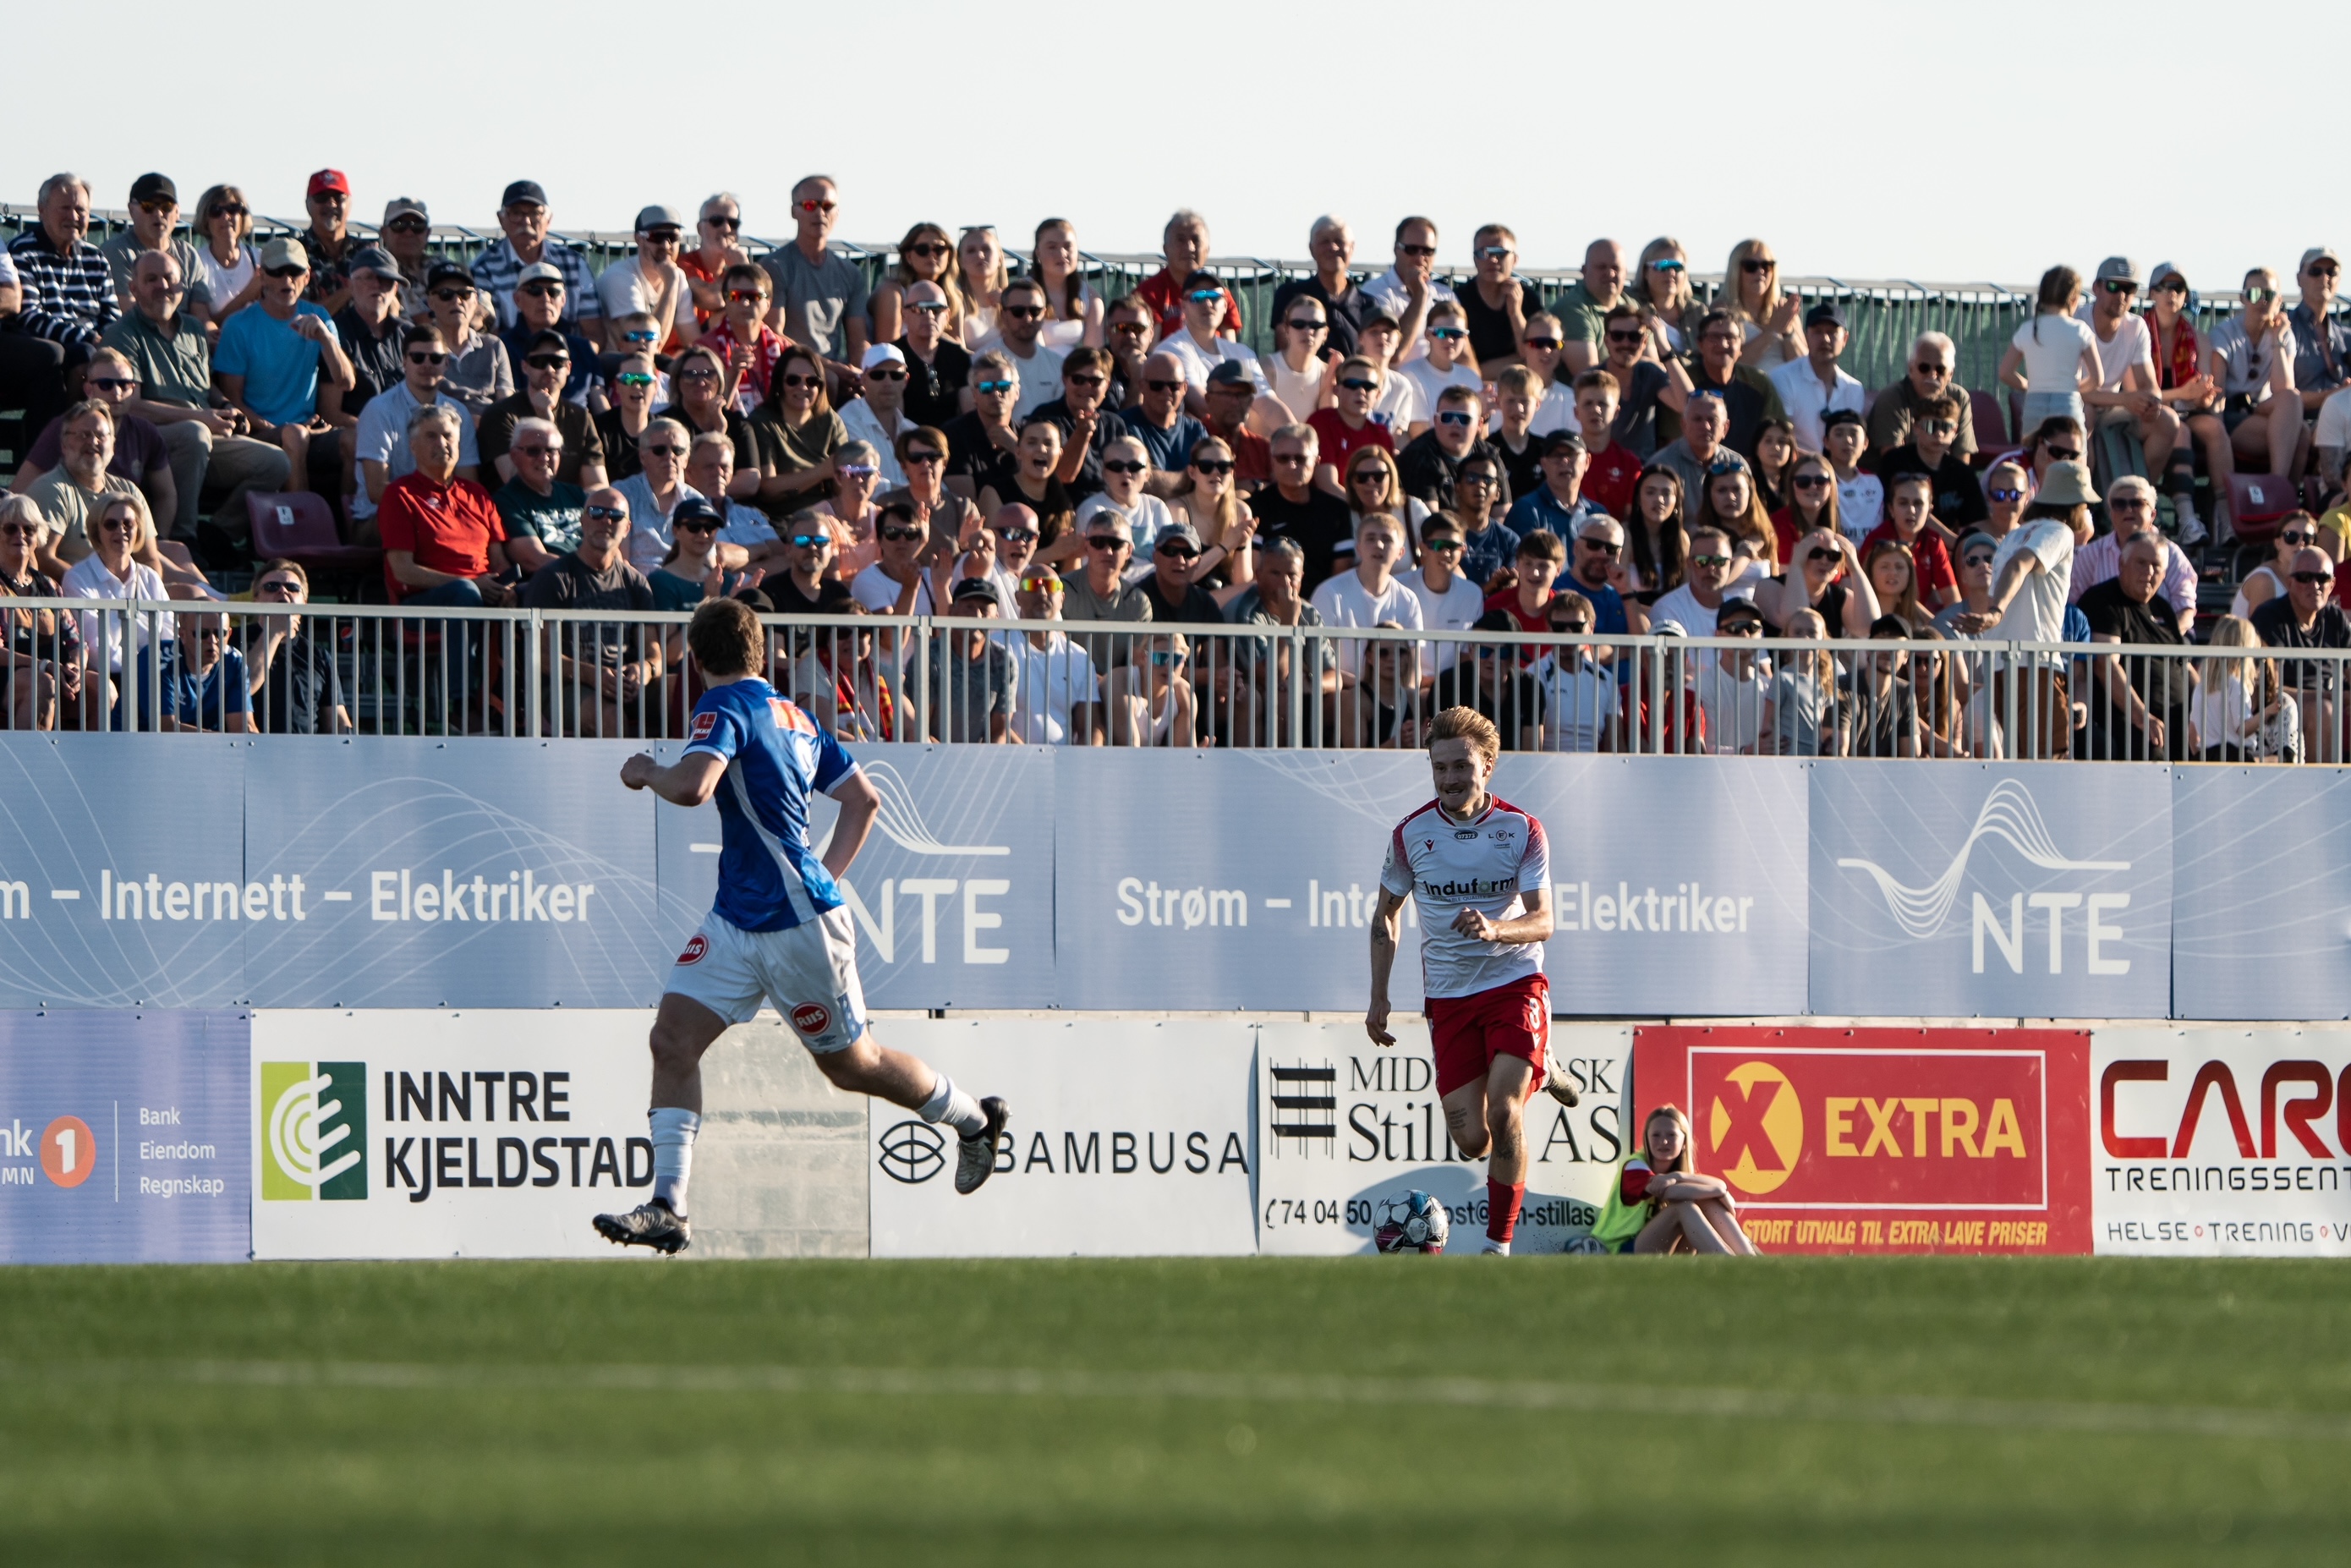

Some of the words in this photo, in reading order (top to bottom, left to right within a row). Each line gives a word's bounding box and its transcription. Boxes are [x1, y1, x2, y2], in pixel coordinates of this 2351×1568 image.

[101, 869, 306, 921] Internett
[371, 869, 595, 922] Elektriker
[1116, 877, 1247, 930] Strøm
[1554, 881, 1754, 933] Elektriker
[839, 878, 1011, 964] NTE
[1972, 891, 2131, 975] NTE
[682, 944, 703, 955] IIS
[796, 1010, 825, 1028] RIIS
[140, 1106, 181, 1126] Bank
[384, 1071, 571, 1121] INNTRE
[2101, 1060, 2351, 1159] CAR
[56, 1128, 76, 1175] 1
[140, 1140, 216, 1160] Eiendom
[1537, 1105, 1622, 1165] AS
[1824, 1097, 2027, 1159] EXTRA
[386, 1137, 655, 1203] KJELDSTAD
[993, 1132, 1251, 1174] BAMBUSA
[140, 1175, 225, 1198] Regnskap
[1281, 1199, 1307, 1225] 74
[1314, 1199, 1340, 1225] 04
[1346, 1199, 1372, 1225] 50
[1743, 1220, 1792, 1244] STORT
[1796, 1220, 1856, 1244] UTVALG
[1861, 1220, 1884, 1244] TIL
[1889, 1220, 1939, 1245] EXTRA
[1946, 1221, 1985, 1245] LAVE
[1988, 1222, 2048, 1246] PRISER
[2107, 1222, 2189, 1242] HELSE
[2208, 1223, 2314, 1242] TRENING
